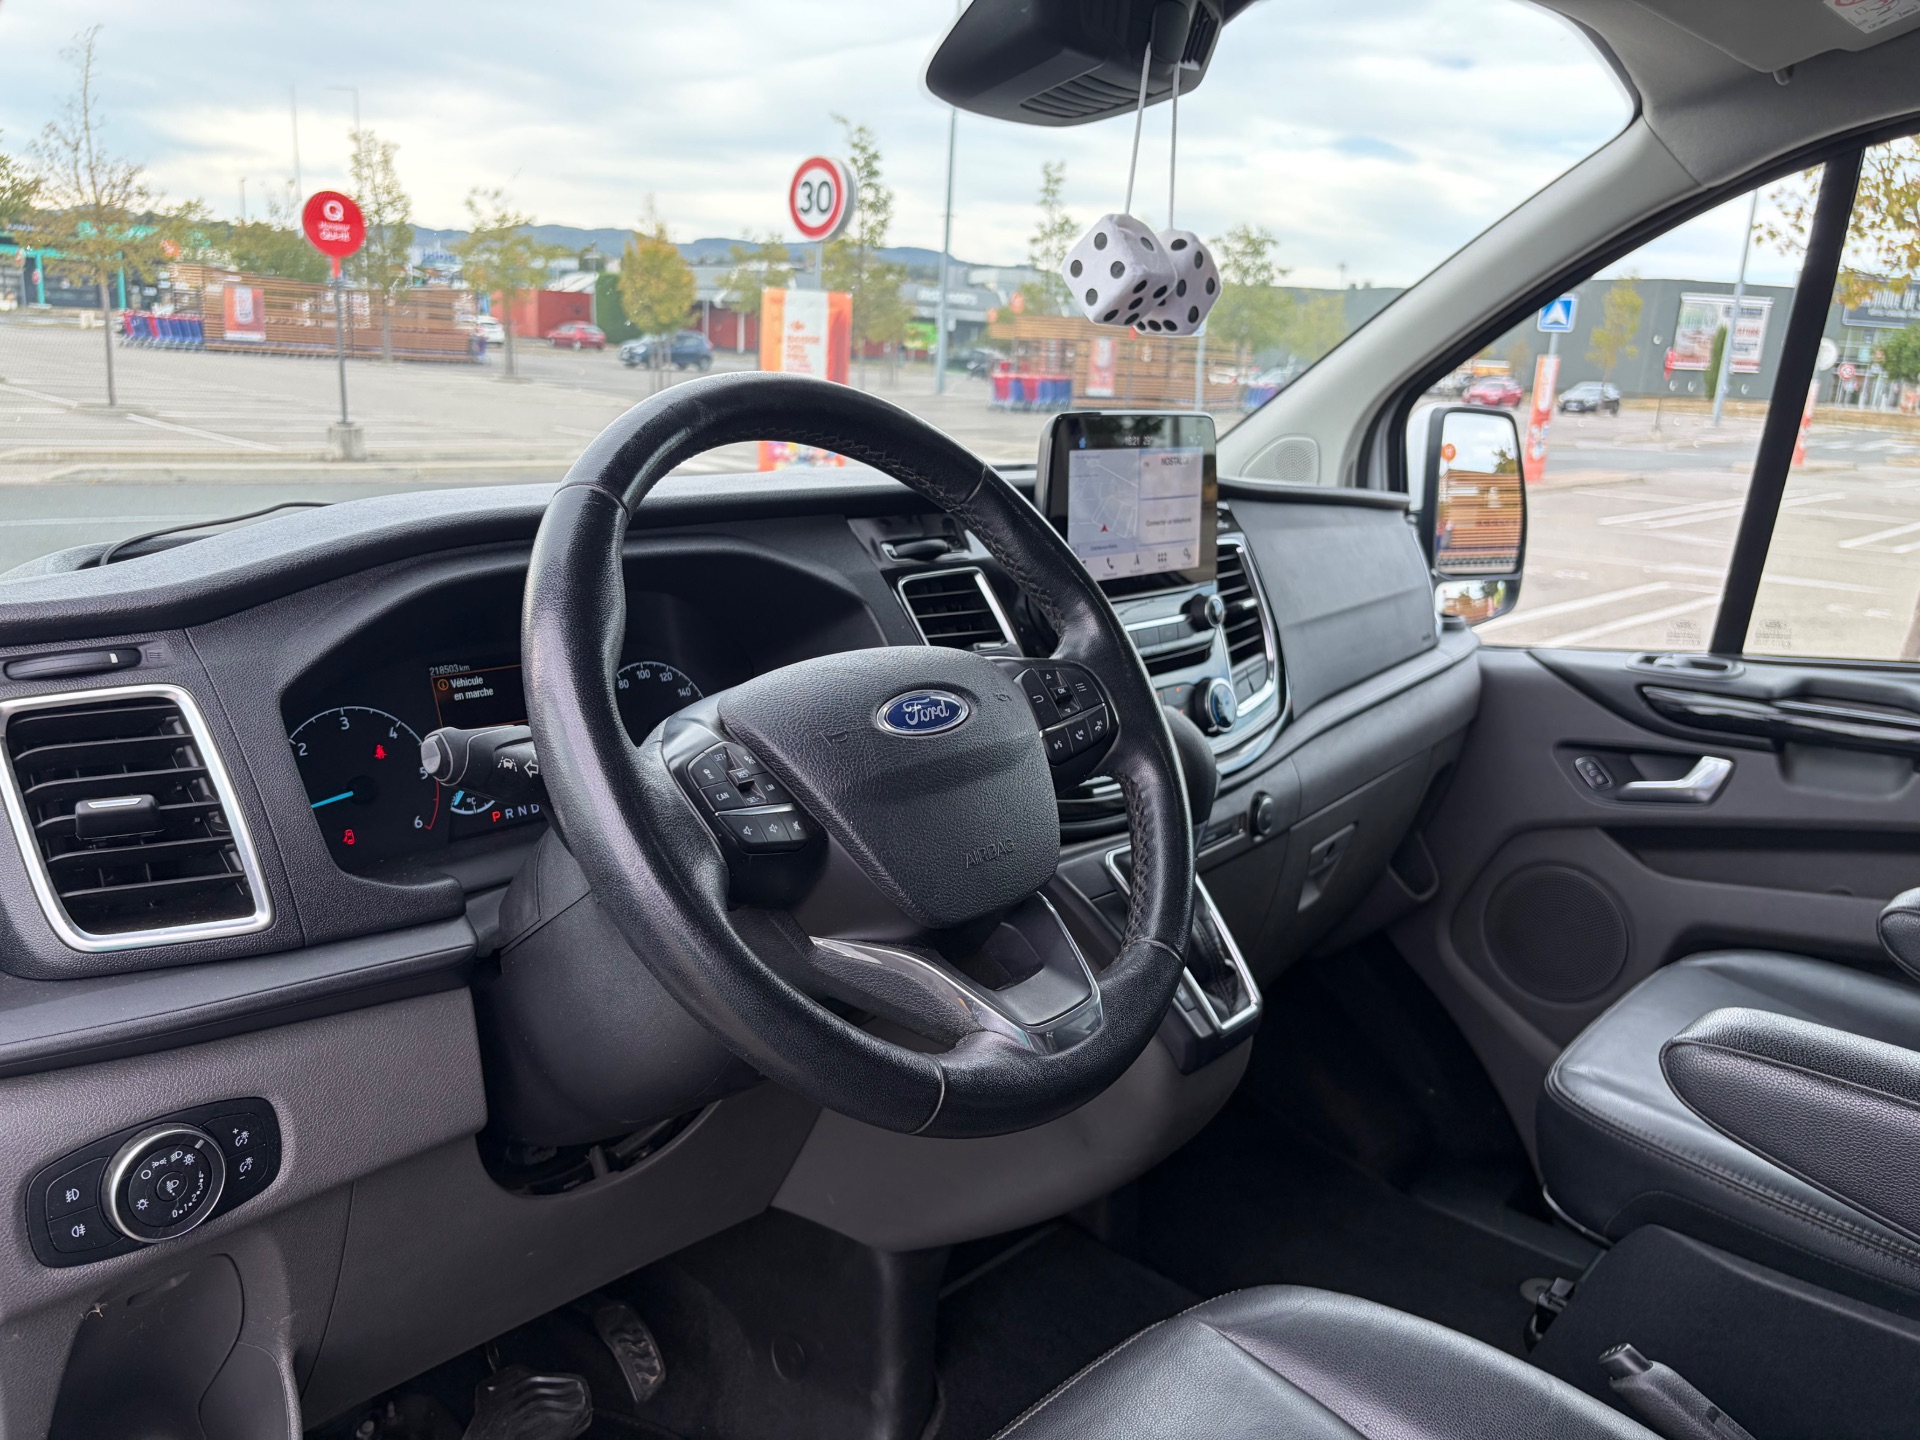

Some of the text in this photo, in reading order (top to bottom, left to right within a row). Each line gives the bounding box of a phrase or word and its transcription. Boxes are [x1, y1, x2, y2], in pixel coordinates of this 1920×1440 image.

[801, 181, 832, 213] 30
[429, 664, 470, 676] 218503 km
[636, 669, 651, 680] 100
[659, 671, 673, 682] 120
[450, 675, 484, 689] Véhicule
[618, 679, 629, 690] 80
[454, 687, 494, 701] en marche
[677, 686, 692, 697] 140
[903, 698, 950, 726] Ford
[340, 716, 350, 730] 3
[389, 727, 398, 739] 4
[297, 742, 308, 756] 2
[419, 767, 429, 780] 5
[716, 792, 730, 801] CAN
[491, 803, 540, 822] P R N D
[414, 816, 423, 829] 6
[965, 837, 1015, 869] AIRBAG
